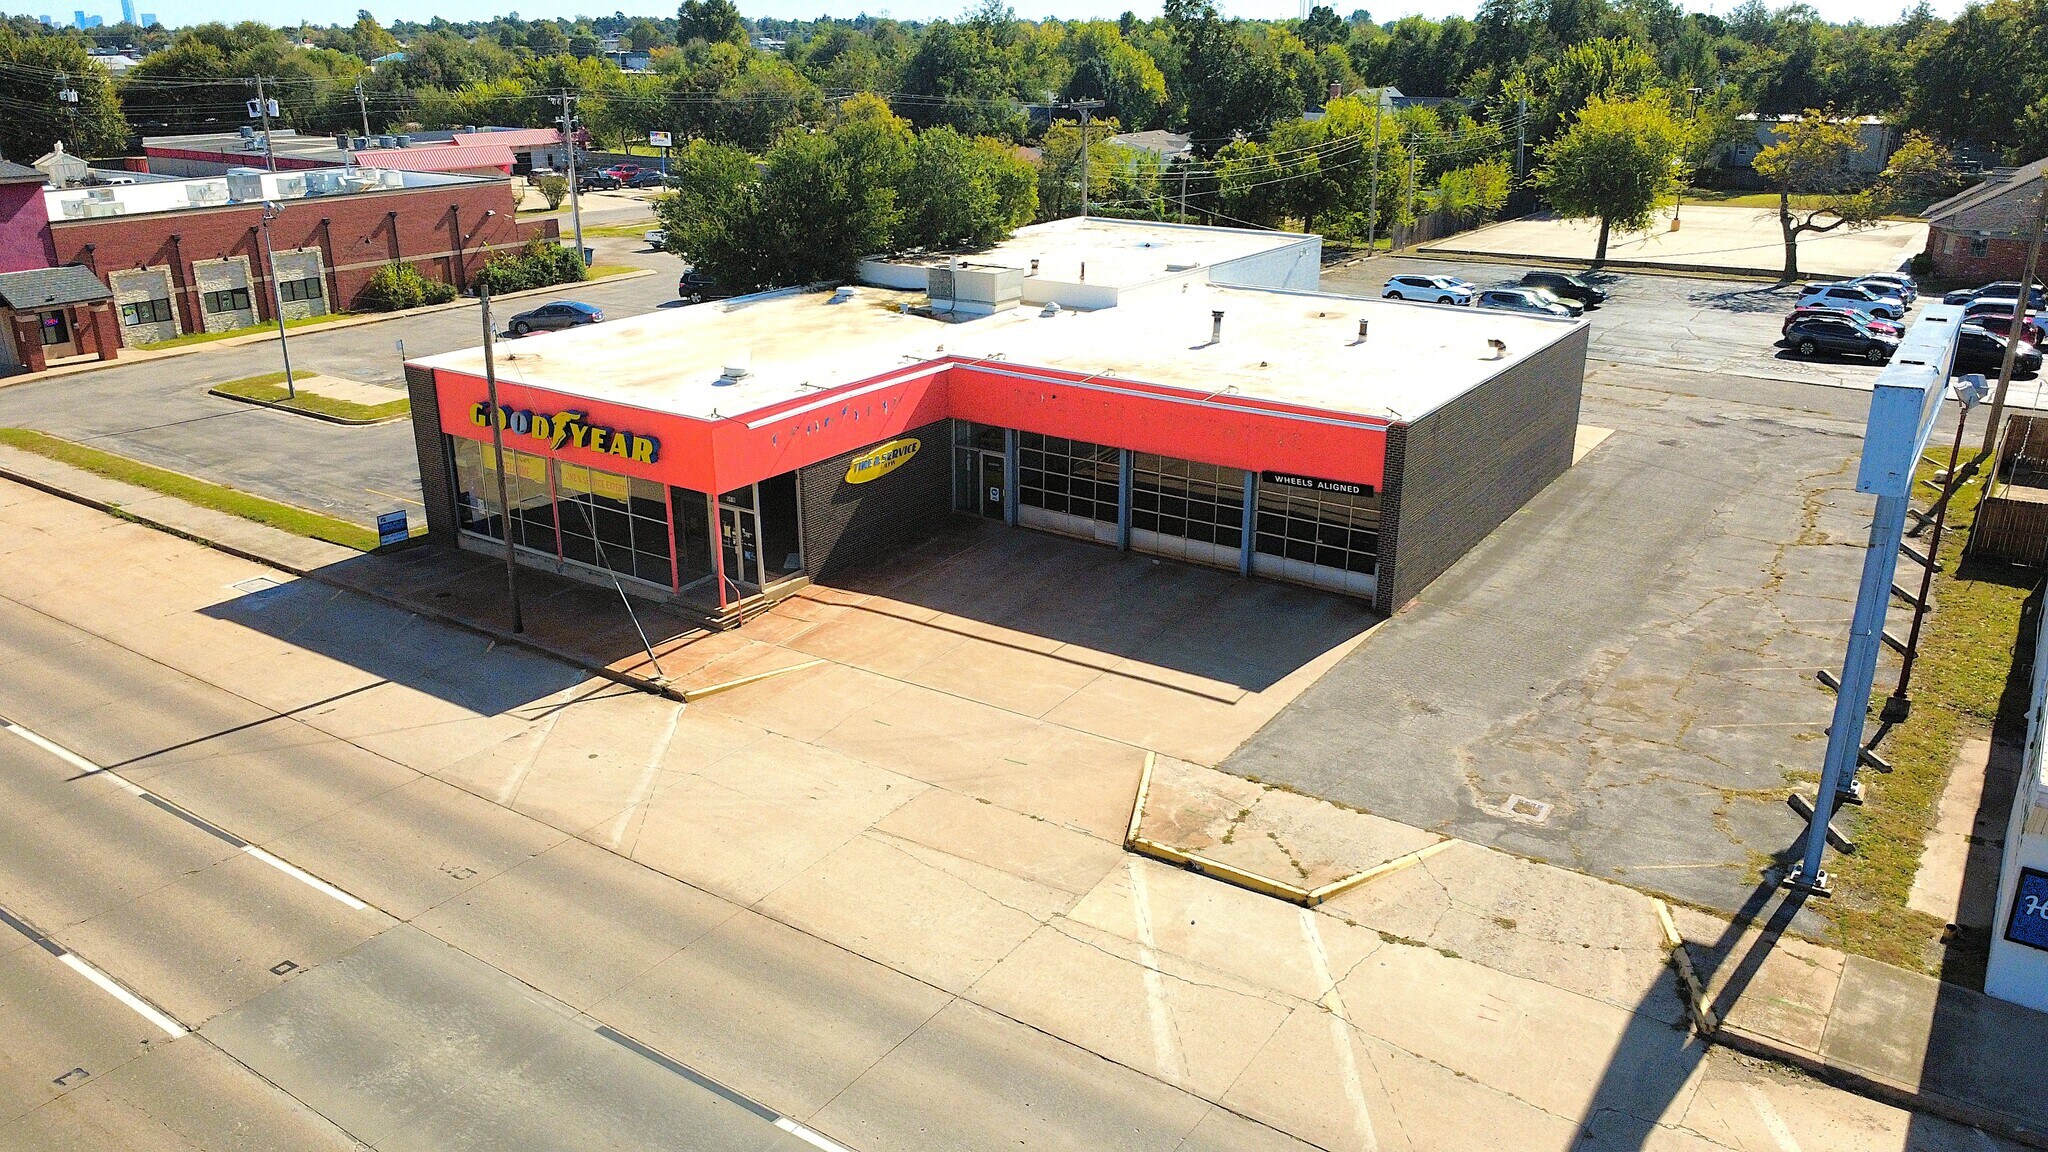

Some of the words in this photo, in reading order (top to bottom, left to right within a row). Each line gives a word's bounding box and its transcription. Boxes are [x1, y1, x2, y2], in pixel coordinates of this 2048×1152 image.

[881, 442, 918, 464] SERVICE
[1274, 475, 1313, 487] WHEELS
[1317, 481, 1360, 494] ALIGNED
